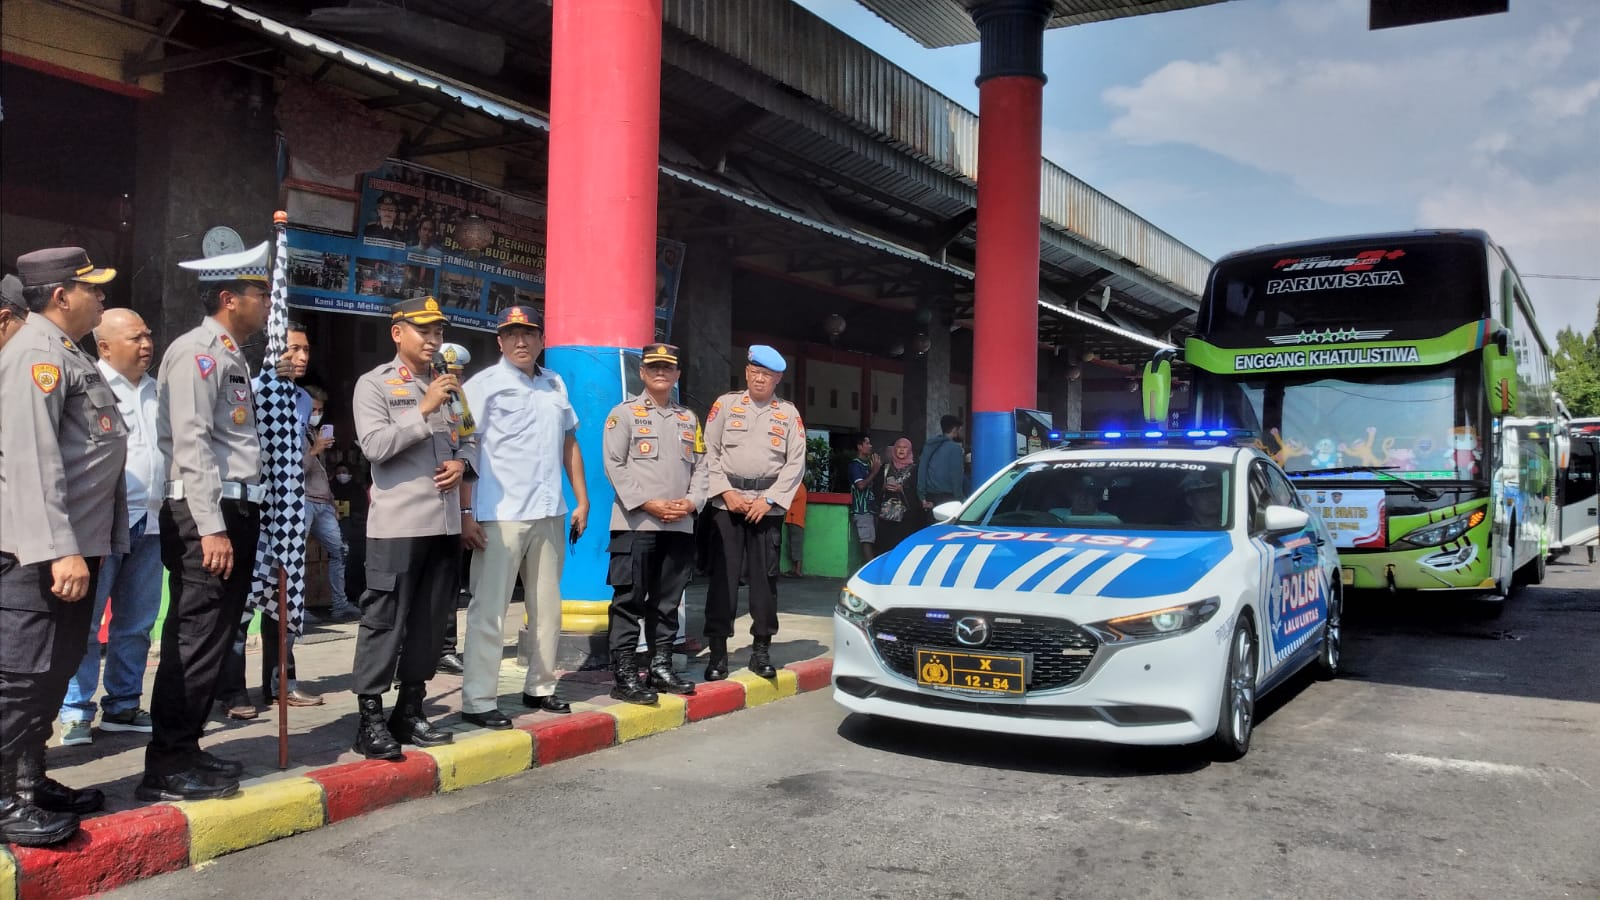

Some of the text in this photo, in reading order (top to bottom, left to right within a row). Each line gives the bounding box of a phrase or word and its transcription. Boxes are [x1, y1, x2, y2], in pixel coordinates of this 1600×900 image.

[498, 236, 547, 257] PERHUBU
[479, 262, 496, 273] TIPE
[495, 266, 502, 274] A
[1266, 270, 1404, 295] PARIWISATA
[314, 297, 334, 306] Kami
[336, 299, 354, 309] Siap
[1234, 346, 1419, 371] ENGGANG KHATULISTIWA
[1053, 461, 1106, 470] POLRES
[1108, 461, 1156, 469] NGAWI
[936, 531, 1155, 549] POLISI
[1282, 566, 1320, 615] POLISI
[1283, 607, 1319, 636] LALU LINTAS
[979, 659, 992, 671] X
[965, 675, 981, 687] 12
[992, 678, 1009, 690] 54
